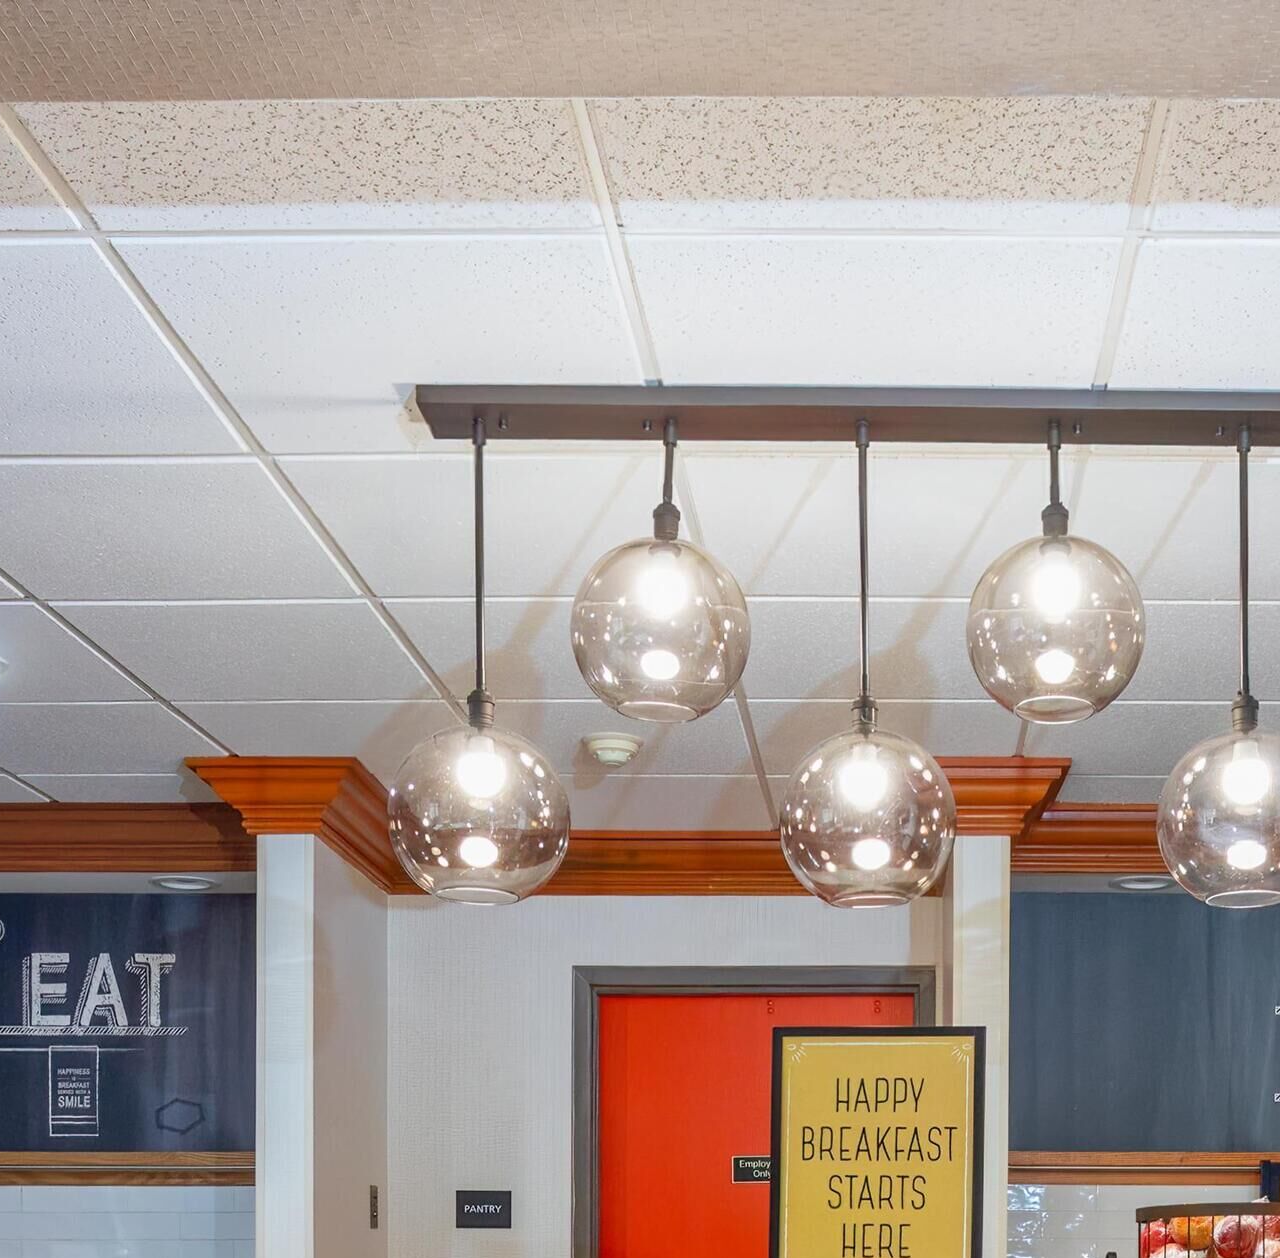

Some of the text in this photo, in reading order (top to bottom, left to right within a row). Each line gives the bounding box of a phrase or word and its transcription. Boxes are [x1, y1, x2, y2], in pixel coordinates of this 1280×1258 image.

[22, 952, 176, 1033] EAT
[58, 1095, 91, 1108] SMILE
[835, 1077, 926, 1113] HAPPY
[801, 1126, 959, 1162] BREAKFAST
[464, 1204, 502, 1214] PANTRY
[827, 1174, 927, 1210] STARTS
[841, 1222, 912, 1258] HERE
